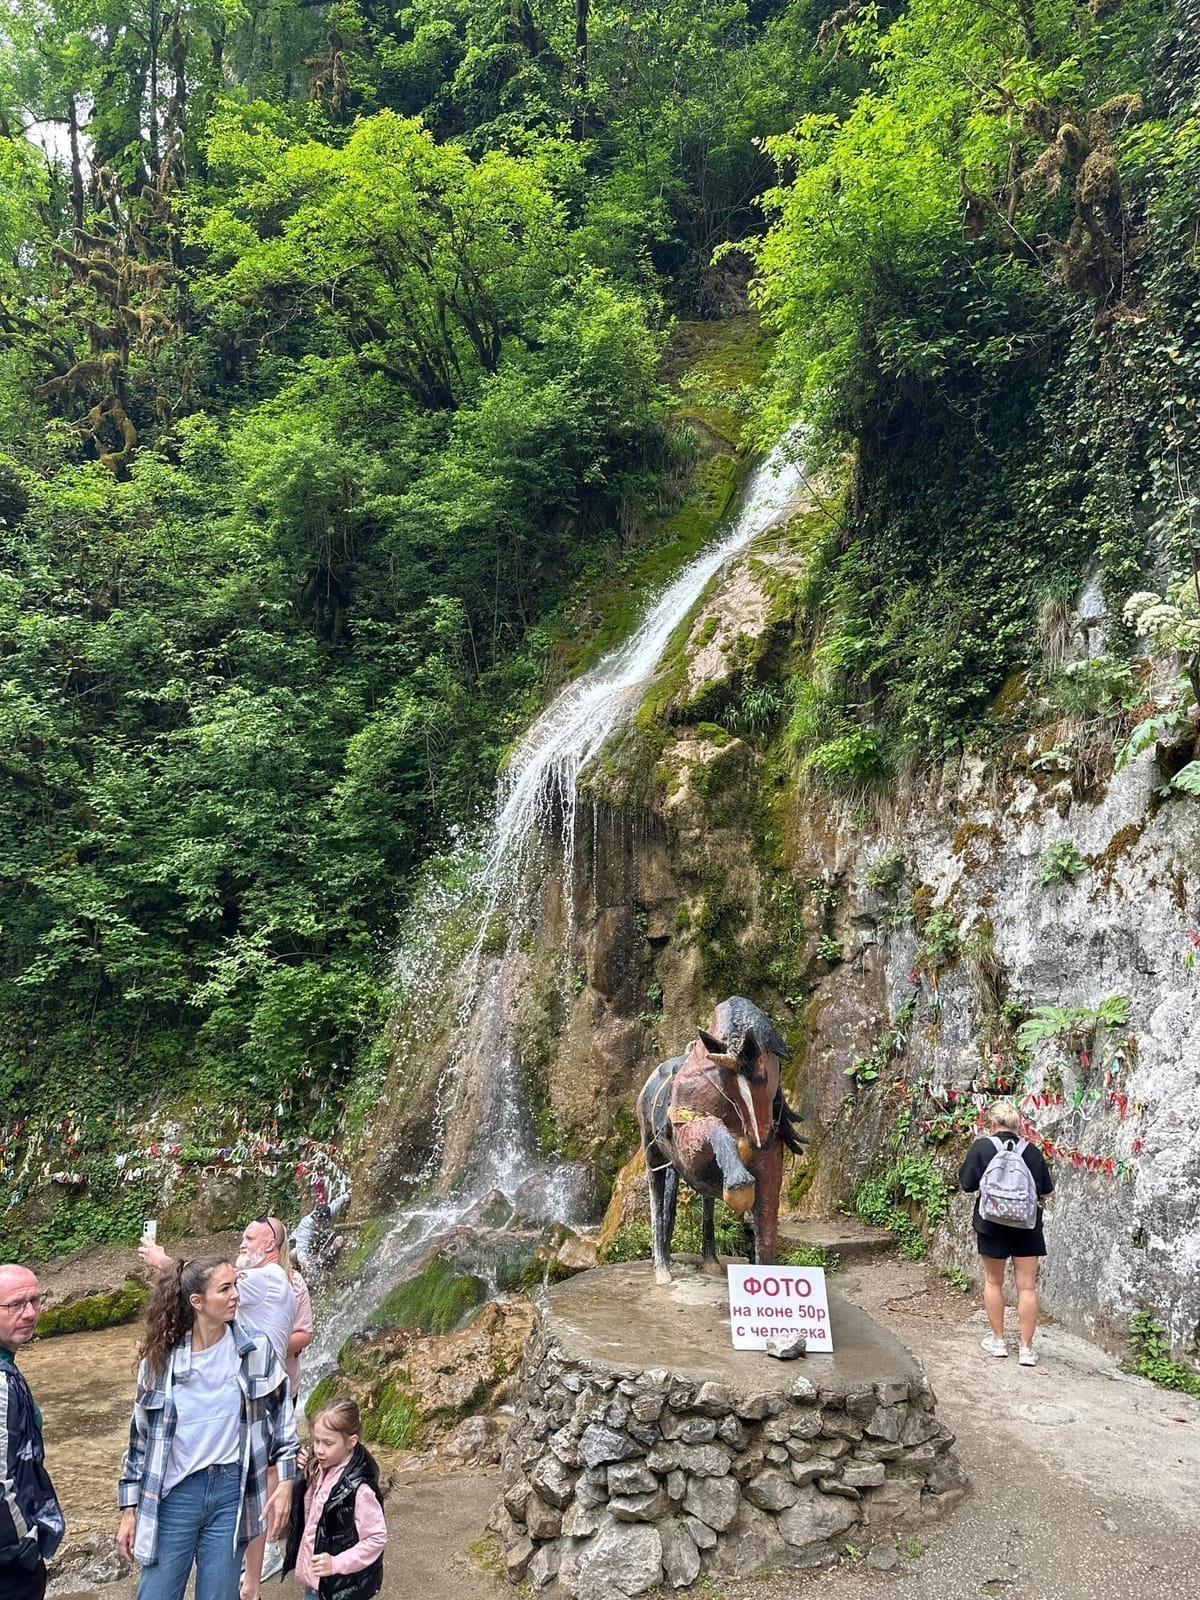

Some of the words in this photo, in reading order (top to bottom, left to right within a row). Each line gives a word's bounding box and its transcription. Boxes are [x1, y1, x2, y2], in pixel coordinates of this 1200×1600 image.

[743, 1277, 812, 1297] ФОТО
[733, 1306, 751, 1317] на
[757, 1307, 793, 1318] коне
[798, 1305, 826, 1322] 50р
[736, 1326, 745, 1337] с
